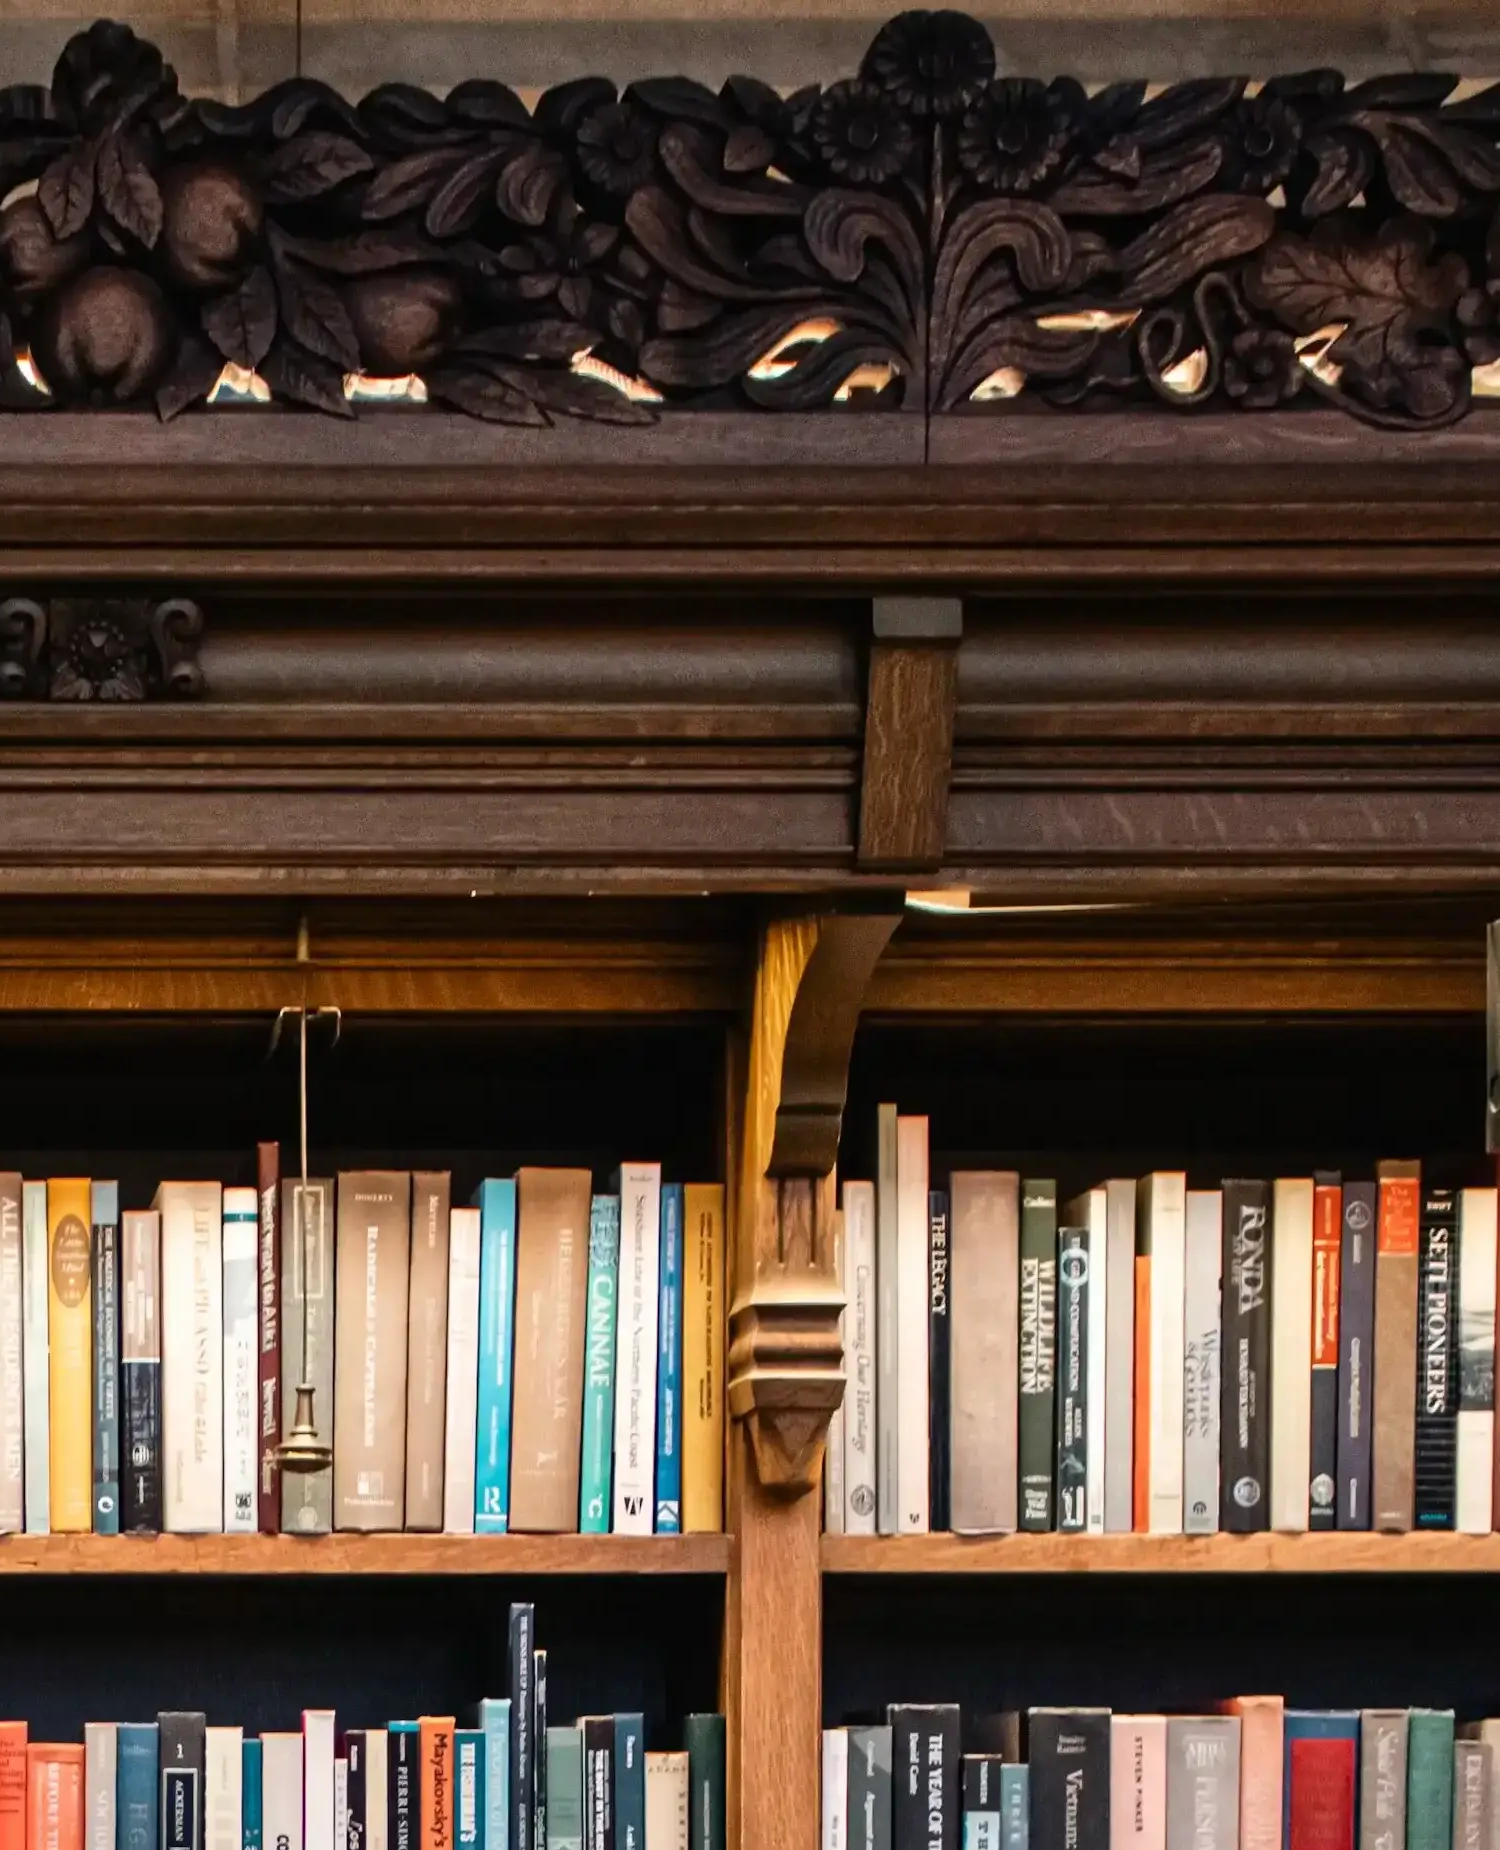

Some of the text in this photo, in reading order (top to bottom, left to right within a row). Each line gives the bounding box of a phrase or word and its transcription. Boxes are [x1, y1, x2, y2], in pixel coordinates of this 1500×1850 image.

[932, 1214, 947, 1316] THE LEGACY
[590, 1274, 612, 1386] CANNAE
[1021, 1259, 1038, 1394] EXTINCTION
[1038, 1259, 1054, 1392] WILDLIFE
[1426, 1228, 1447, 1413] SETI PIONEERS
[432, 1733, 448, 1847] Mayakovsky's
[929, 1734, 942, 1764] THE
[929, 1769, 941, 1810] YEAR
[929, 1812, 942, 1834] OF
[1066, 1770, 1082, 1848] Vietnam:
